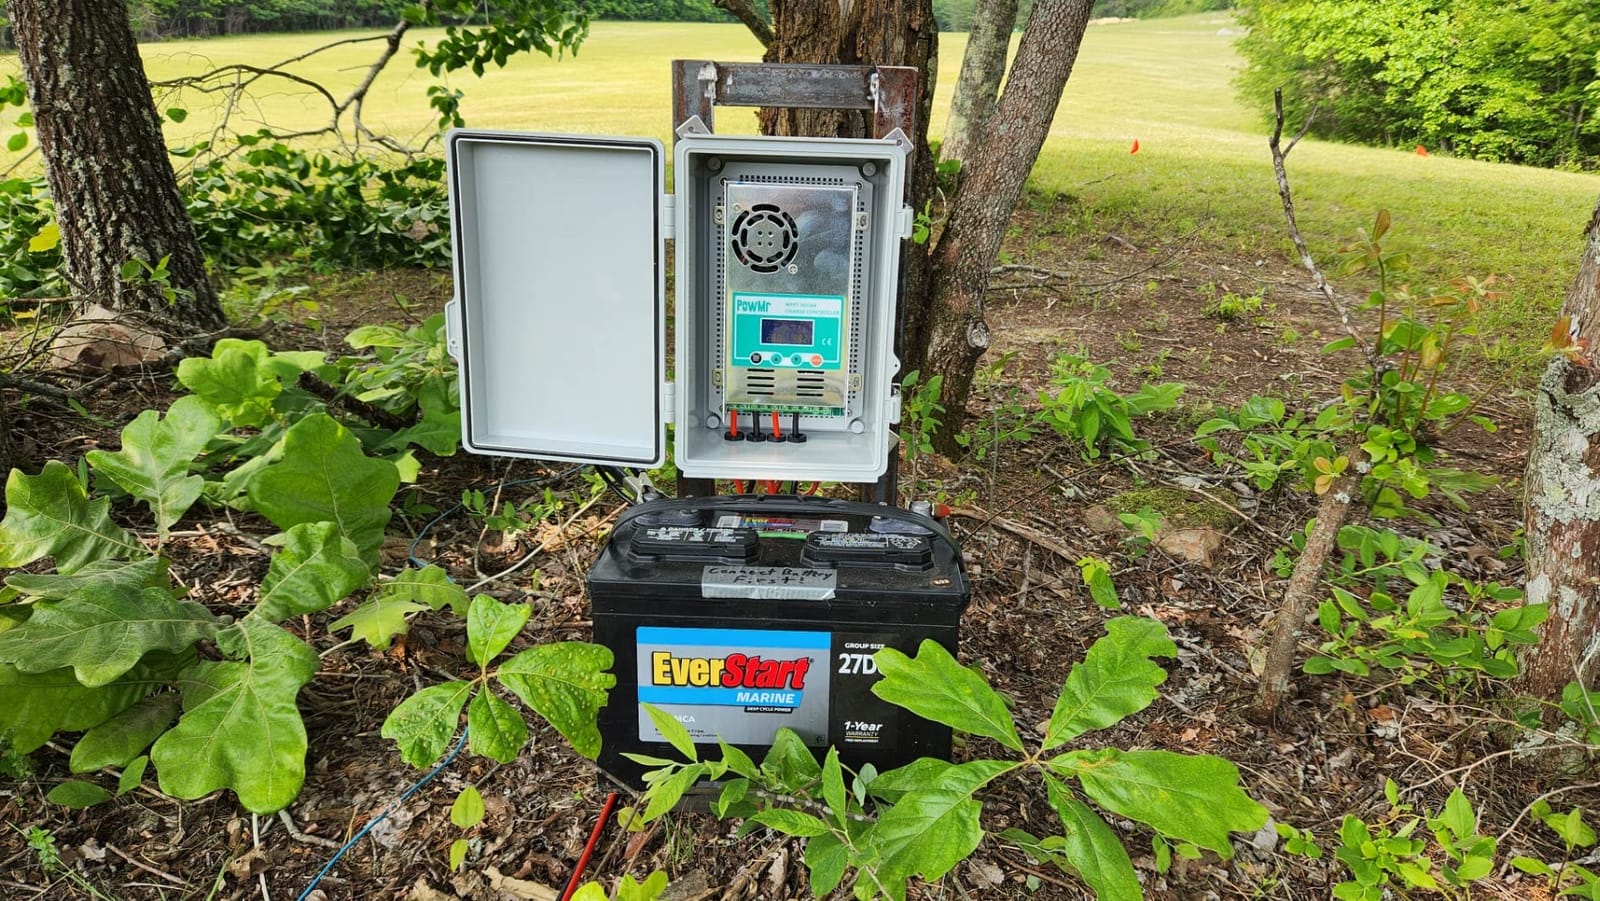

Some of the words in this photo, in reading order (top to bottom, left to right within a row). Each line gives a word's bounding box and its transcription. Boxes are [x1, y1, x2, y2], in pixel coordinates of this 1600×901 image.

[708, 567, 776, 576] Connect
[782, 568, 832, 580] Battery
[652, 651, 810, 689] EverStart
[838, 653, 877, 674] 27D
[736, 692, 796, 704] MARINE
[844, 721, 883, 731] 1-Year
